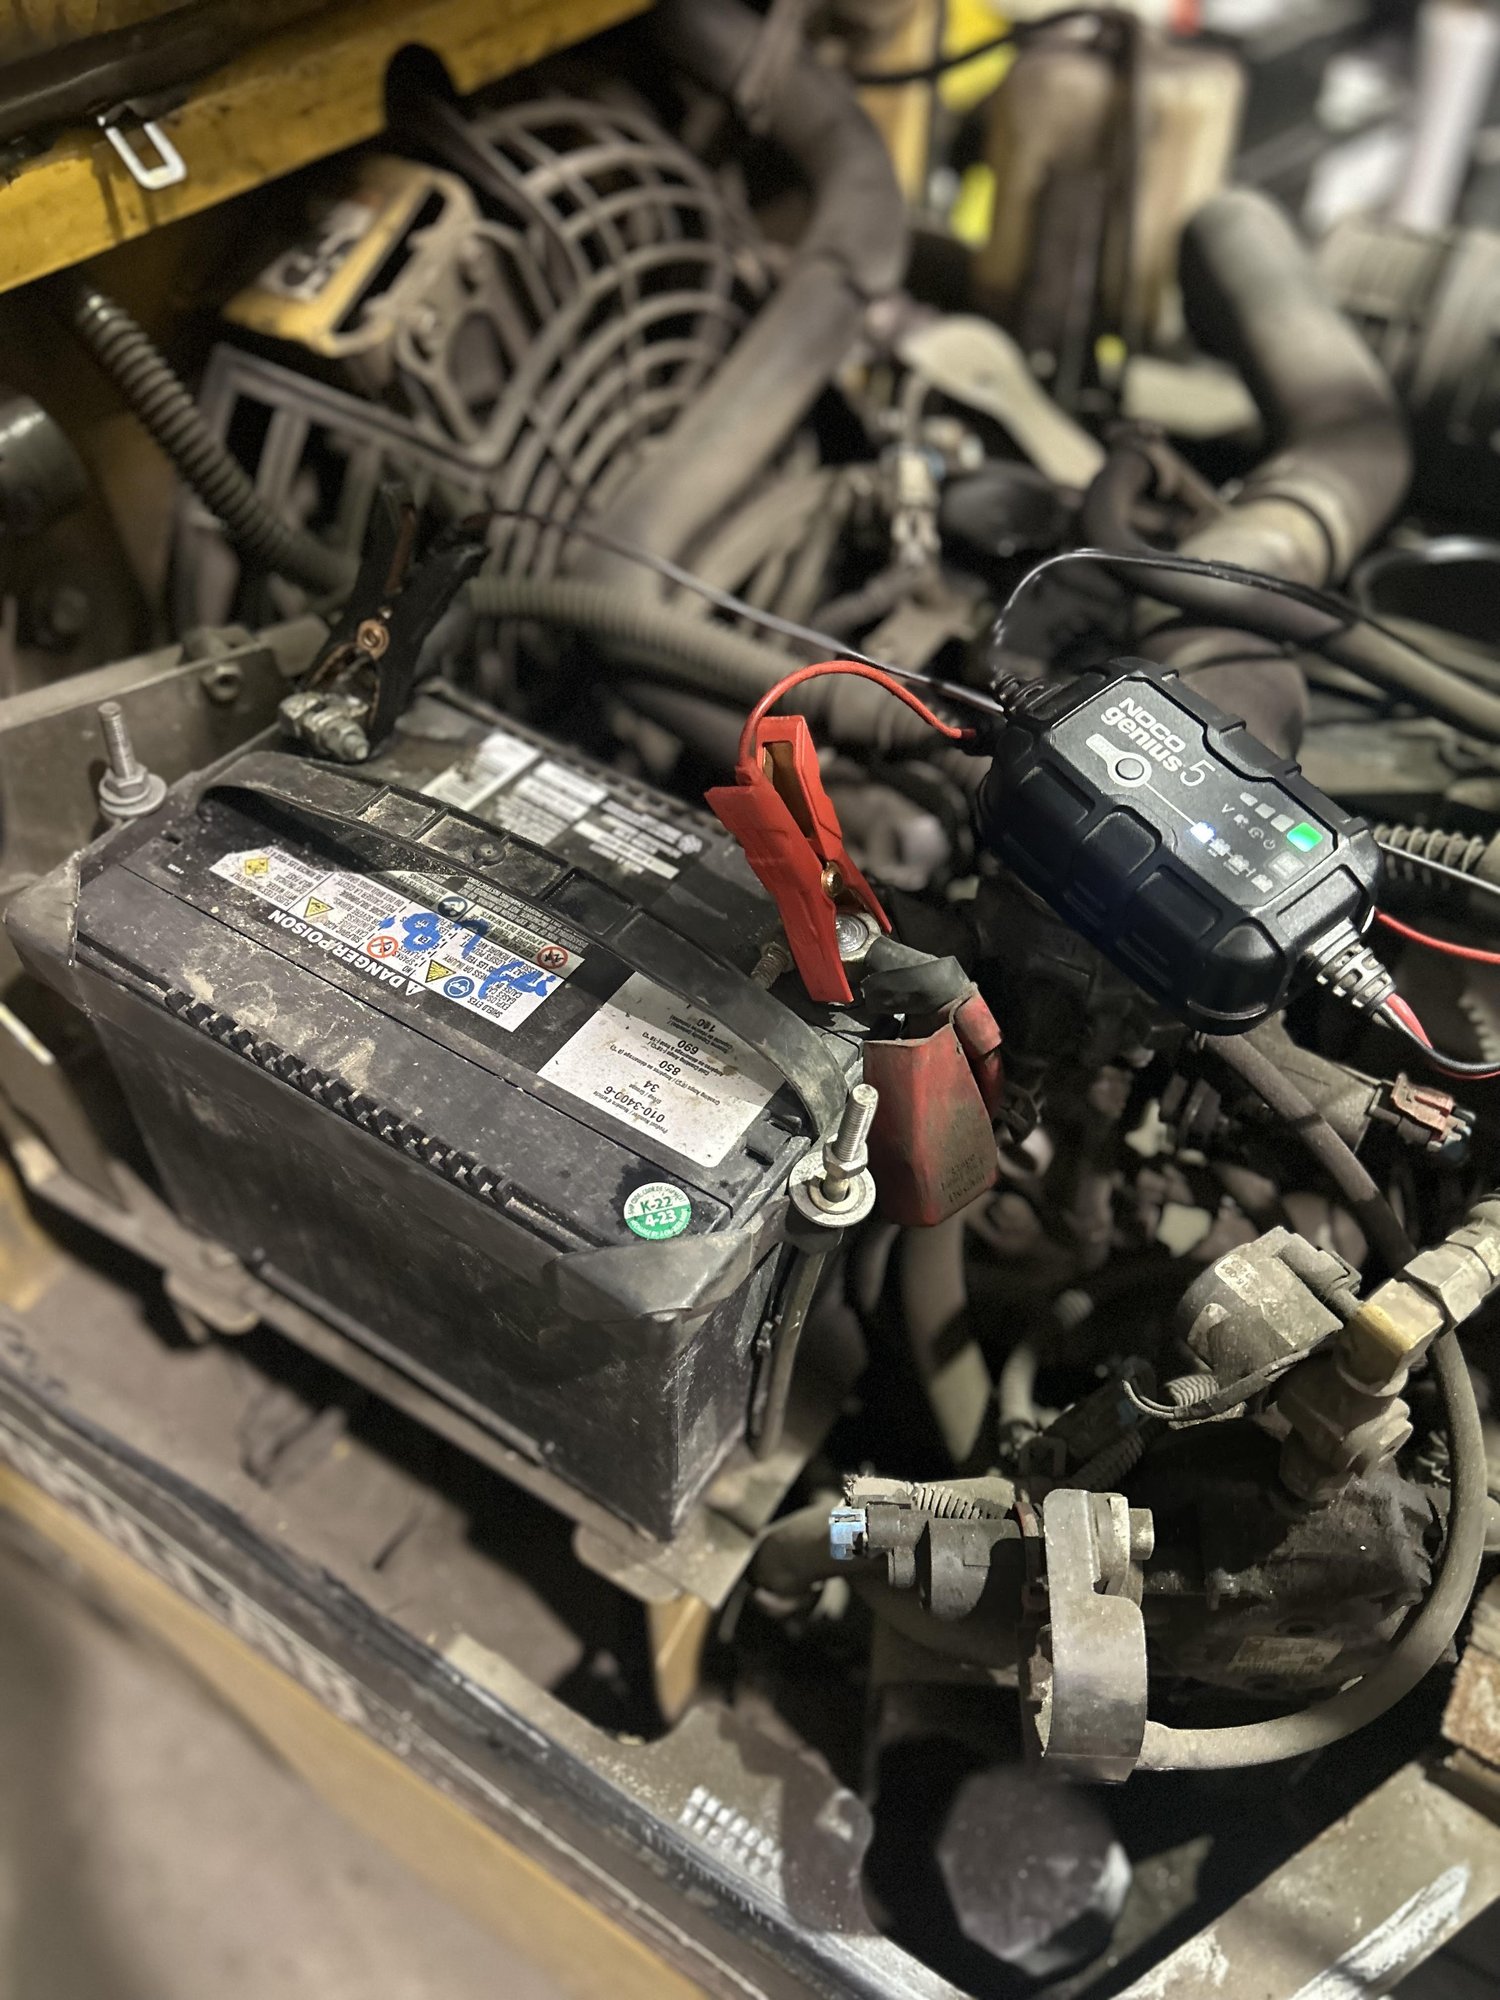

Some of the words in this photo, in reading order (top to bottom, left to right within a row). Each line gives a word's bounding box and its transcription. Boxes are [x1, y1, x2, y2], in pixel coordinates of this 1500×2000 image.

[1119, 697, 1186, 752] NOCO
[352, 887, 363, 895] LA
[408, 872, 447, 895] INSTRUCTIONS
[360, 891, 384, 906] CAUSER
[350, 907, 373, 922] SEVERE
[379, 901, 397, 913] PEUT
[337, 918, 357, 932] CAUSE
[343, 912, 375, 932] BLINDNESS
[503, 923, 517, 932] DES
[354, 927, 368, 937] CAN
[266, 908, 406, 988] DANGER/POISON
[536, 939, 547, 947] LA
[390, 949, 415, 965] SPARKS
[484, 944, 511, 962] RENDRE
[441, 953, 465, 969] INJURY.
[462, 964, 474, 973] OR
[473, 959, 488, 970] LES
[401, 965, 413, 973] NO
[494, 990, 517, 1005] GASES
[501, 984, 523, 999] CAUSE
[464, 995, 484, 1008] EYES.
[480, 1003, 503, 1018] SHIELD
[676, 1038, 699, 1055] 690
[658, 1059, 681, 1076] 850
[642, 1079, 660, 1093] 34
[602, 1084, 665, 1123] 010-3400-6
[640, 1196, 673, 1223] K-22
[645, 1209, 677, 1227] 4-23
